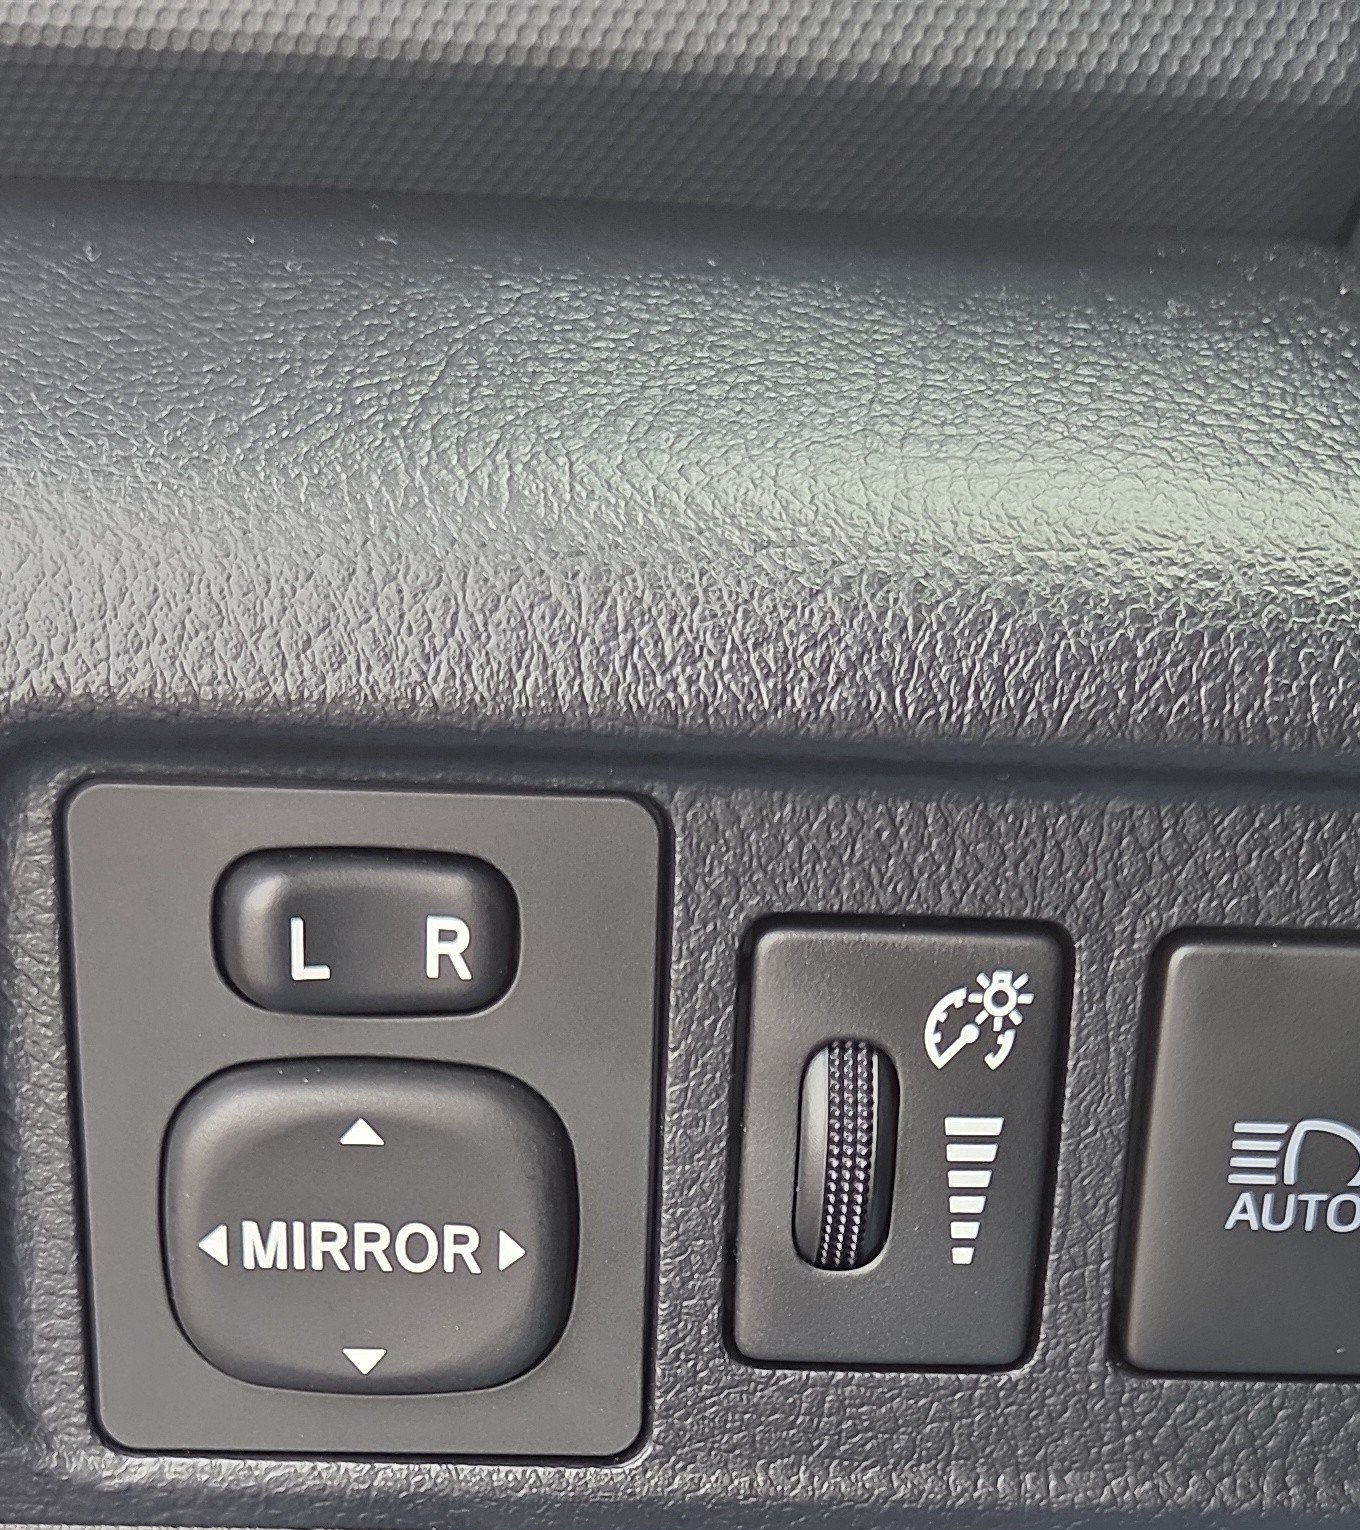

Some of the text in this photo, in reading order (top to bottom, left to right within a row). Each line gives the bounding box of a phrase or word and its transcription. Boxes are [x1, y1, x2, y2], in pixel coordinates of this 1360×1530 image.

[290, 915, 472, 981] L R
[241, 1220, 482, 1274] MIRROR
